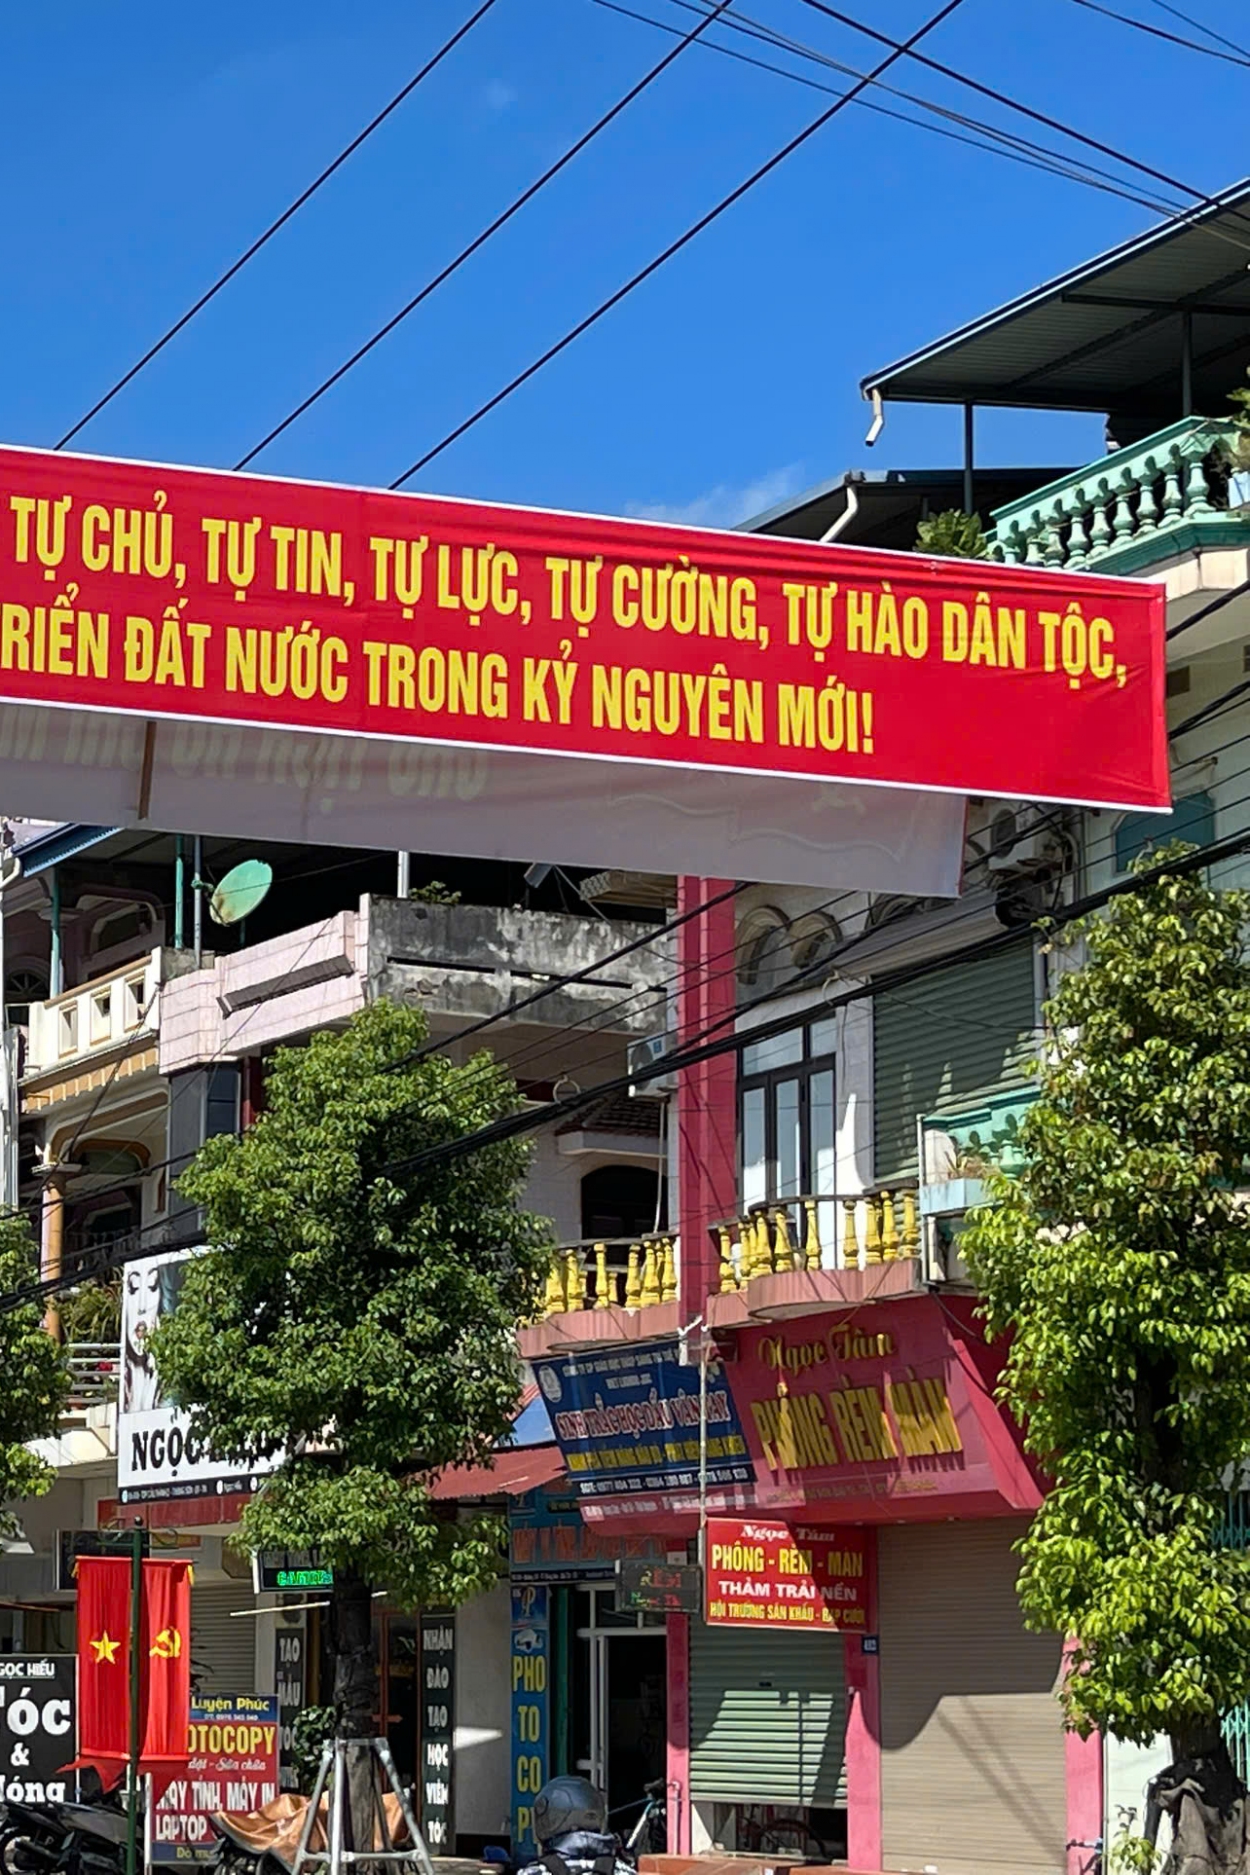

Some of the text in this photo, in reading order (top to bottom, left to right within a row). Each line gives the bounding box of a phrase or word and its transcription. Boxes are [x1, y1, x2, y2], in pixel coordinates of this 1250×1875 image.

[11, 495, 72, 581] TỰ
[82, 490, 186, 589] CHỦ,
[202, 516, 262, 602] TỰ
[271, 525, 355, 606] TIN,
[370, 535, 429, 619] TỰ
[438, 542, 531, 626] LỰC,
[546, 555, 603, 638] TỰ
[613, 554, 769, 650] CƯỜNG,
[783, 581, 838, 663] TỰ
[847, 581, 928, 659] HÀO
[943, 591, 1026, 669] DÂN
[1039, 602, 1127, 689] TỘC,
[123, 597, 212, 688] ĐẤT
[226, 620, 348, 703] NƯỚC
[363, 641, 508, 718] TRONG
[524, 639, 578, 724] KỶ
[593, 663, 764, 743] NGUYÊN
[779, 675, 874, 754] MỚI!
[758, 1336, 828, 1377] Ngọc
[619, 1404, 647, 1440] HỌC
[750, 1382, 838, 1471] PHÔNG
[829, 1374, 900, 1463] RÈM
[887, 1365, 963, 1458] MÀN
[741, 1524, 789, 1541] Ngọc
[711, 1540, 764, 1571] PHÔNG
[779, 1543, 812, 1575] RÈM
[718, 1577, 770, 1597] THẢM
[775, 1580, 816, 1599] TRẢI
[26, 1659, 55, 1677] HIẾU
[512, 1655, 546, 1692] PHO
[191, 1696, 270, 1712] Luyện Phúc
[518, 1705, 540, 1742] TO
[10, 1742, 30, 1766] &
[427, 1743, 448, 1771] HỌC
[517, 1755, 541, 1793] CO
[227, 1776, 258, 1811] MÁY
[156, 1814, 207, 1841] LAPTOP
[517, 1806, 535, 1843] P
